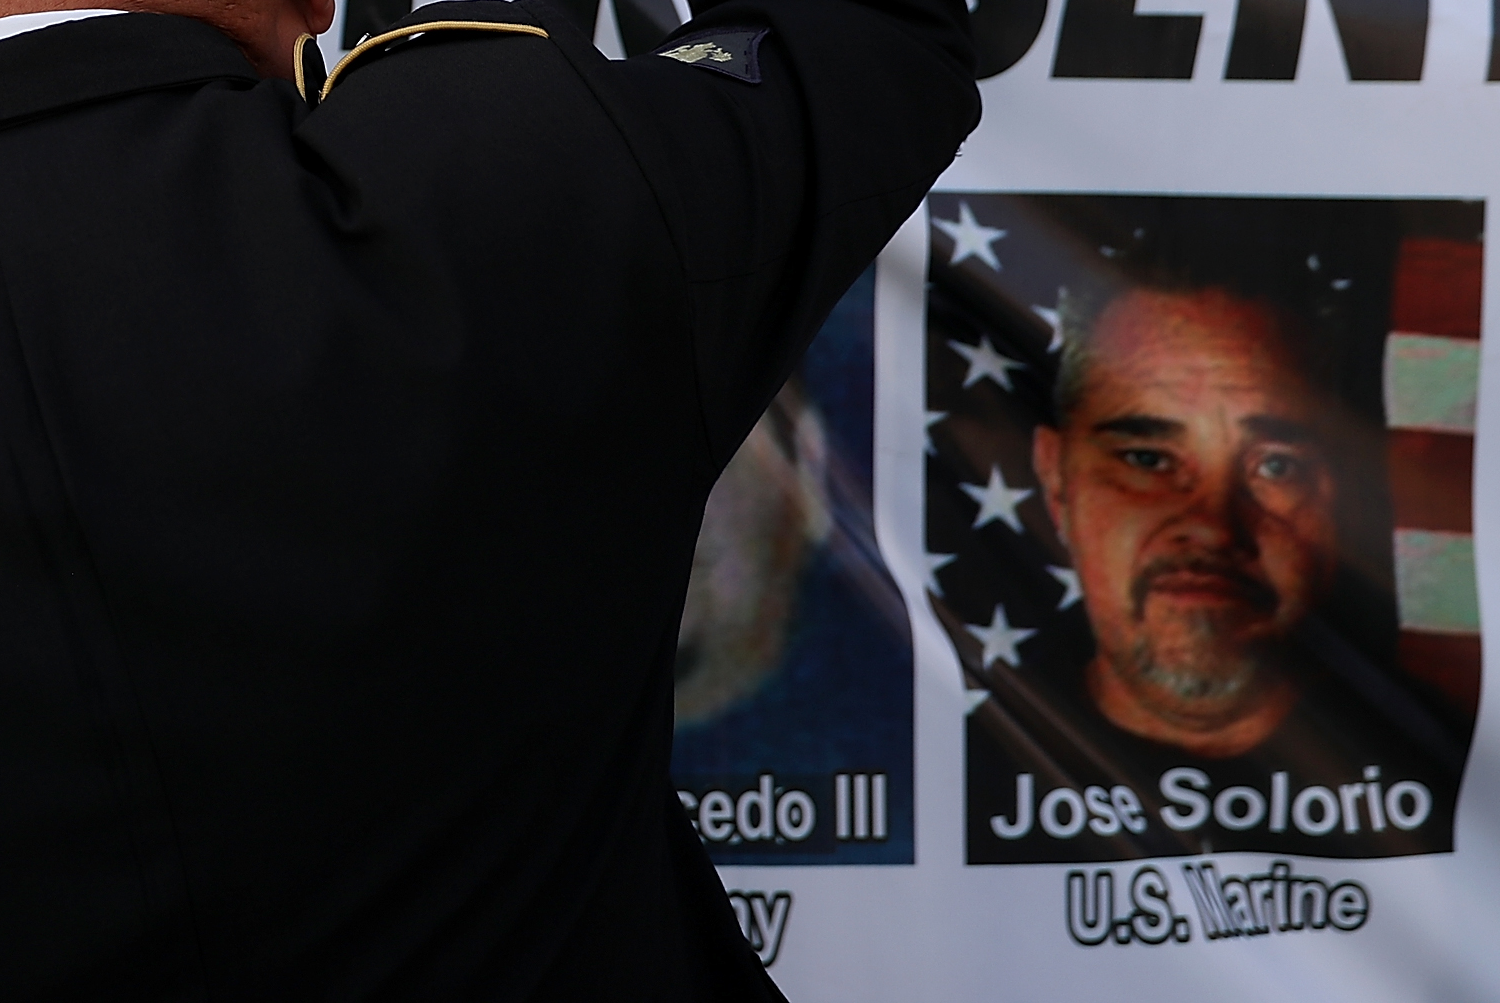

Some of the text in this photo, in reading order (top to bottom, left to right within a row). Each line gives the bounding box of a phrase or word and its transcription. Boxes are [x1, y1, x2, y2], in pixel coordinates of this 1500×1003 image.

[989, 764, 1435, 841] Jose Solorio
[1066, 860, 1370, 946] U.S. Marine
